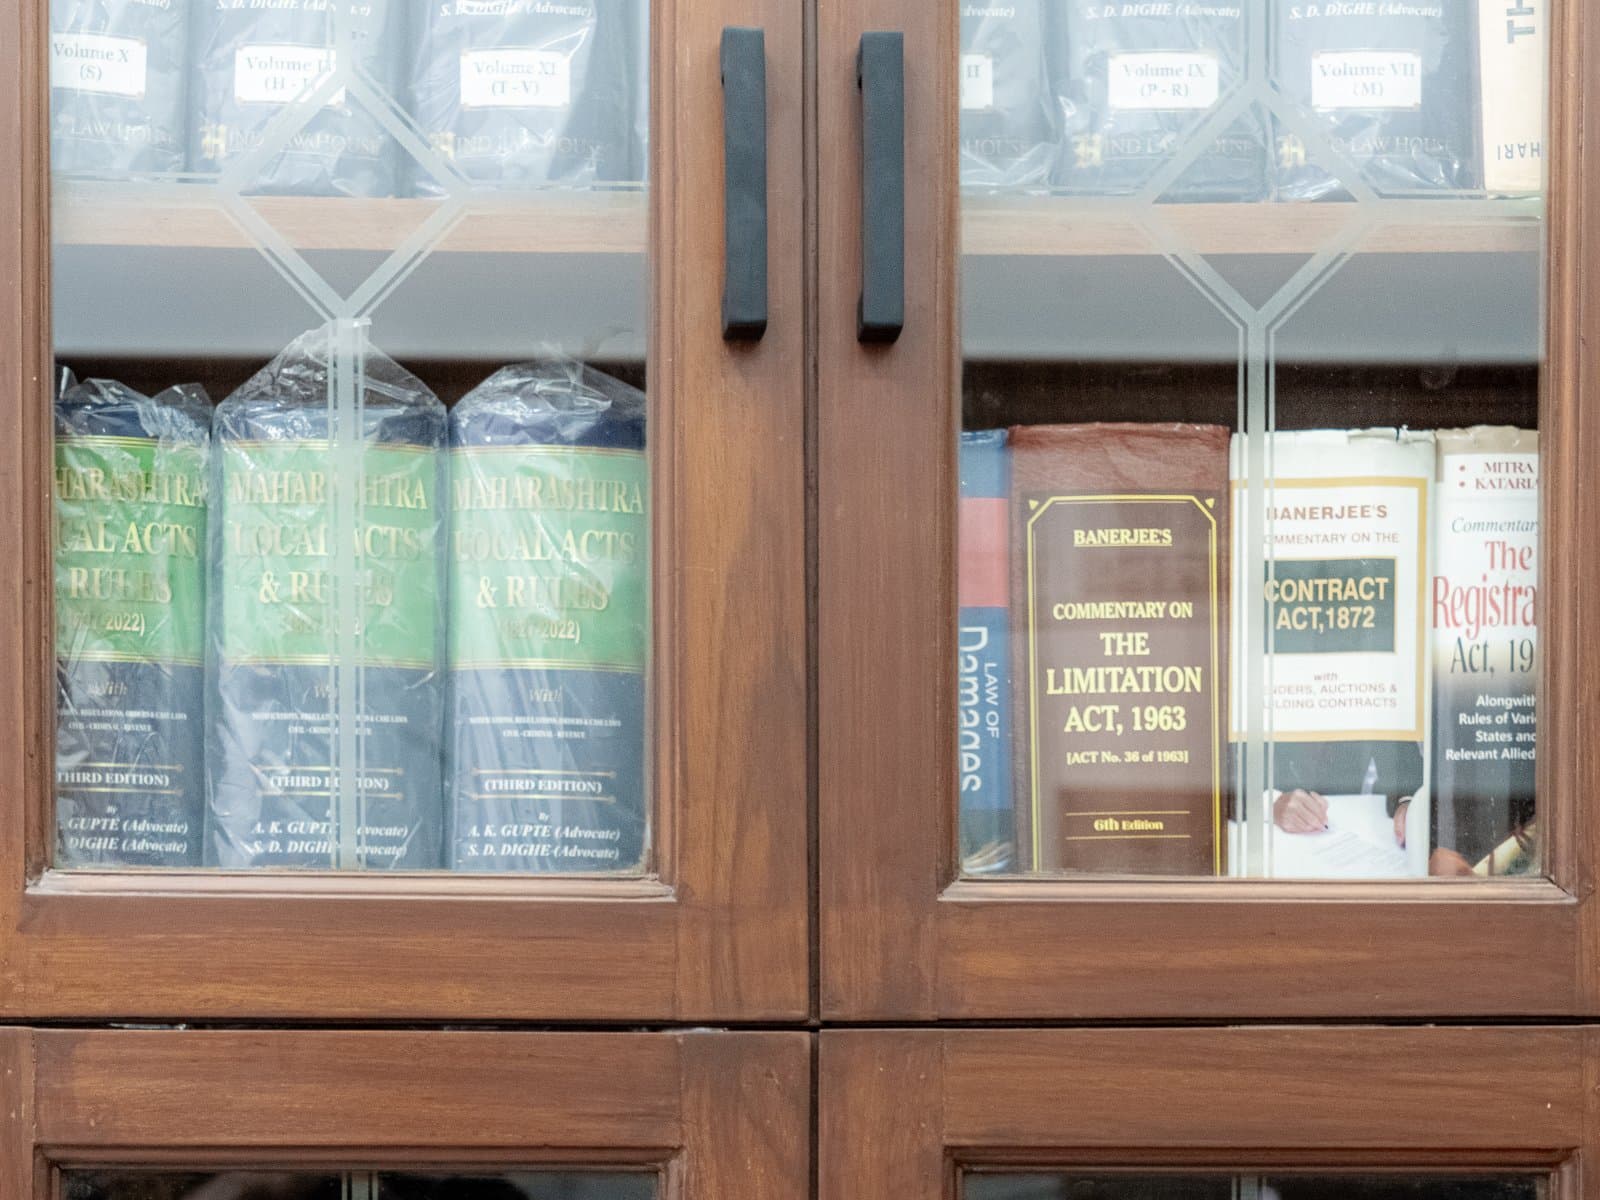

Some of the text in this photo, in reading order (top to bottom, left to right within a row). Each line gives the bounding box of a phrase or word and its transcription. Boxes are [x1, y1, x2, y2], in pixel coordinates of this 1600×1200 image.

[1122, 3, 1172, 16] DIGHE
[1326, 3, 1374, 16] DIGHE
[54, 43, 113, 61] Volume
[79, 65, 102, 82] (S)
[1123, 63, 1182, 78] Volume
[1320, 63, 1384, 78] Volume
[1484, 461, 1534, 474] MITRA
[122, 520, 197, 557] ACTS
[559, 528, 634, 562] ACTS
[1485, 540, 1532, 572] The
[478, 576, 498, 609] &
[1264, 577, 1389, 603] CONTRACT
[1053, 601, 1194, 620] COMMENTARY ON
[1276, 606, 1375, 636] ACT,1872
[1099, 632, 1150, 657] THE
[1450, 636, 1495, 676] Act,
[1046, 666, 1202, 695] LIMITATION
[984, 663, 1000, 738] LAW OF
[1063, 705, 1187, 736] ACT, 1963
[1459, 712, 1508, 726] Rules of
[1476, 730, 1512, 743] States
[1446, 748, 1535, 761] Relevant Allied
[108, 773, 170, 788] EDITION)
[538, 779, 602, 795] EDITION)
[123, 818, 188, 834] (Advocate)
[1093, 818, 1119, 831] 6th
[501, 825, 620, 841] GUPTE (Advocate)
[122, 838, 187, 854] (Advocate)
[500, 844, 620, 860] DIGHE (Advocate)
